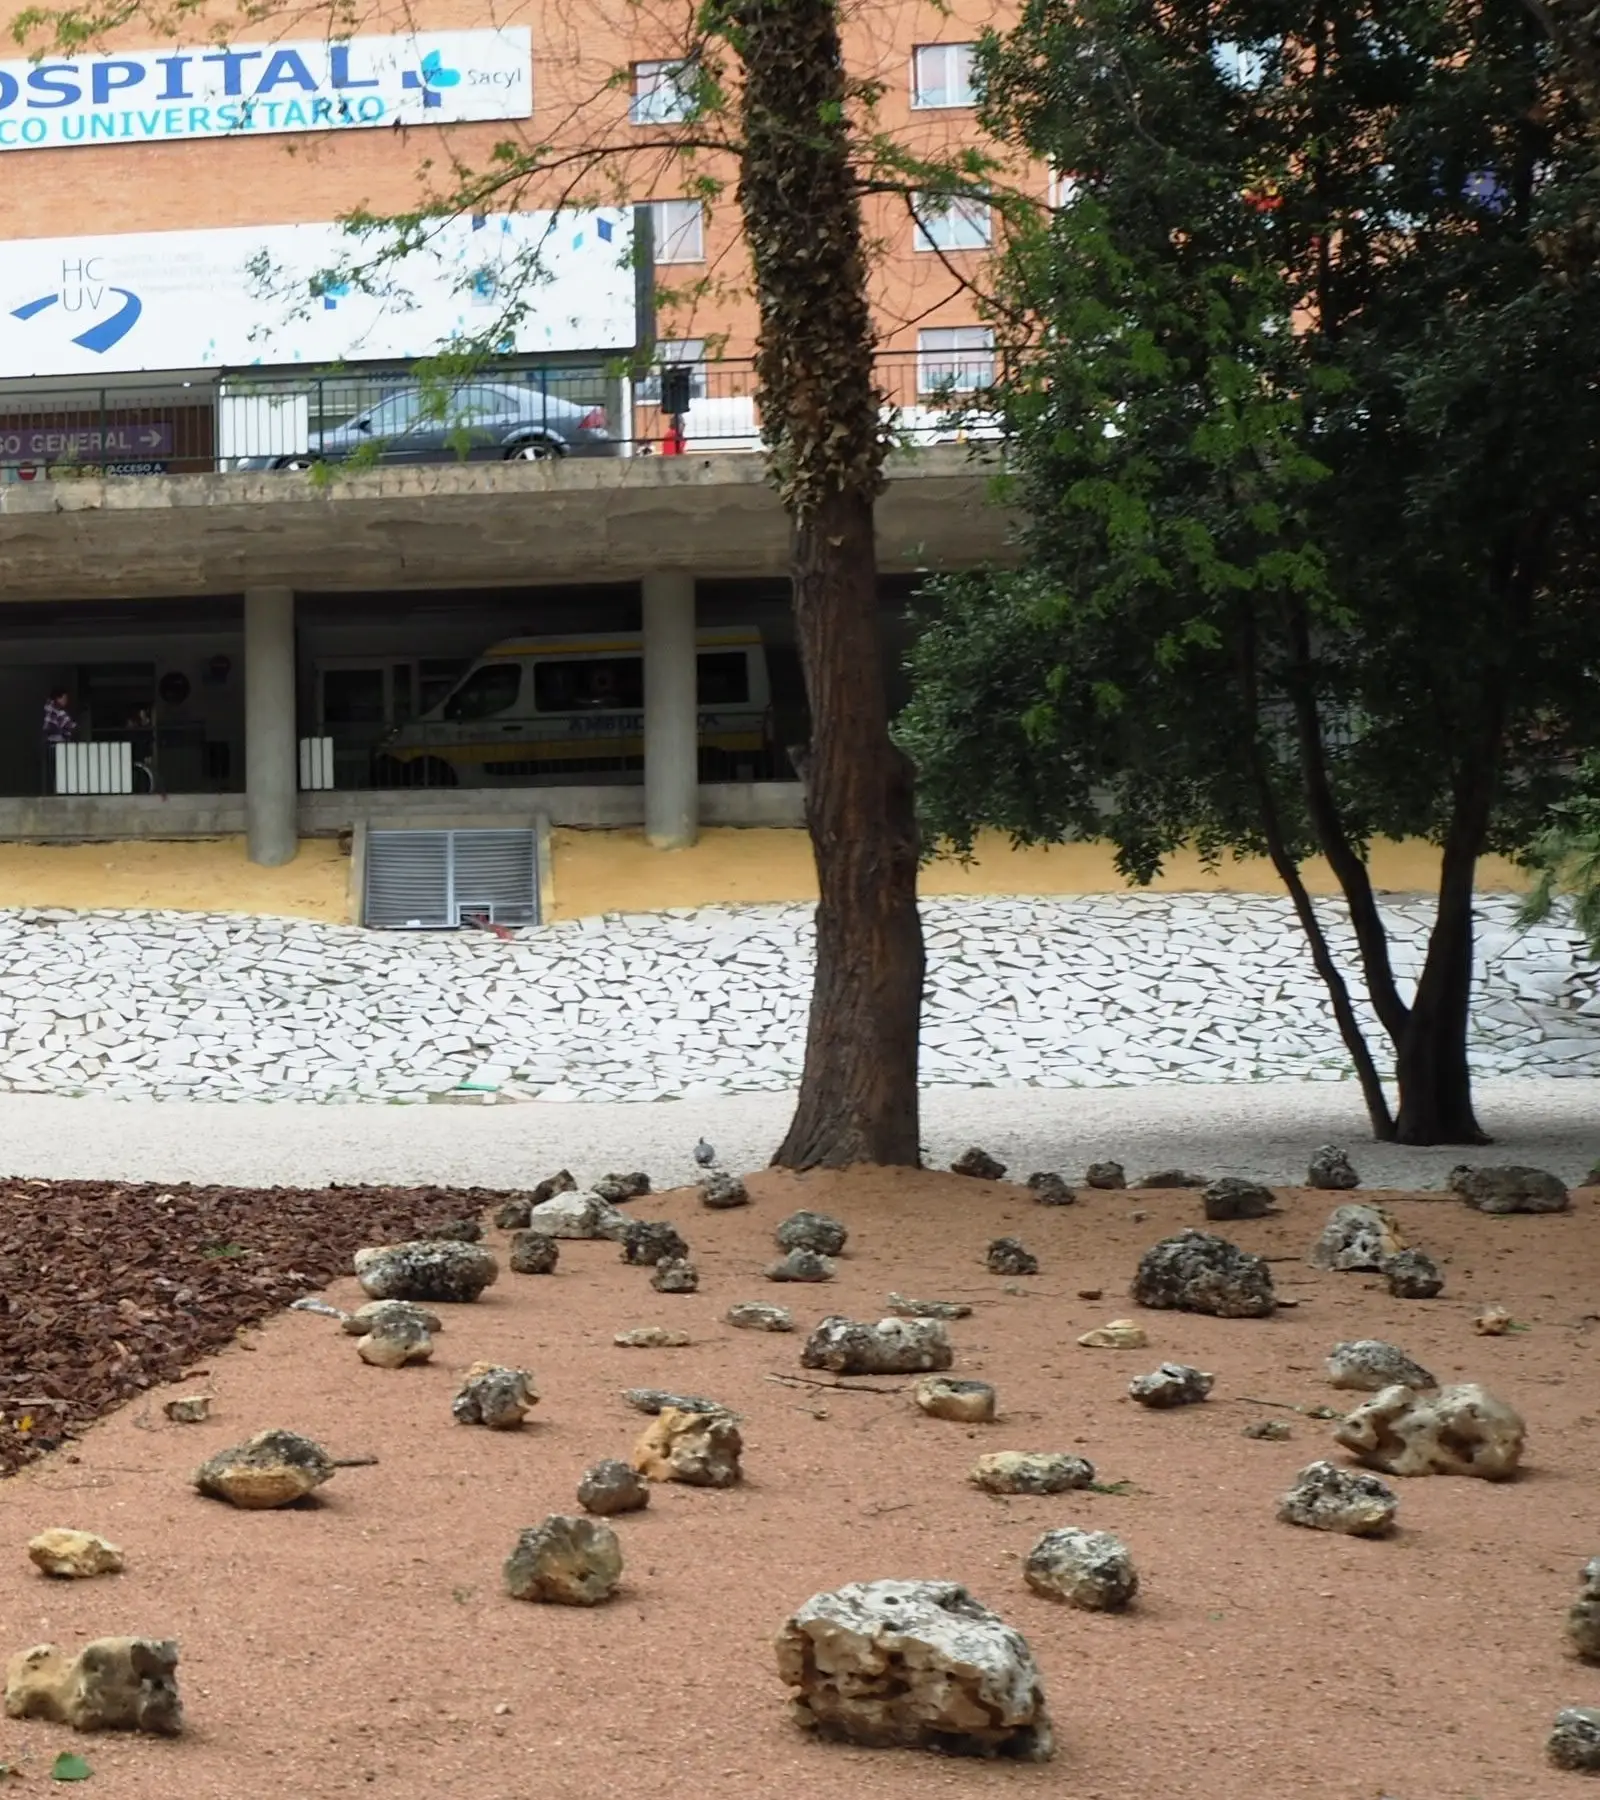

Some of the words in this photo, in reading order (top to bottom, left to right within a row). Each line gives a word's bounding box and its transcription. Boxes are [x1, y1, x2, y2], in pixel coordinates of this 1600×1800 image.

[467, 67, 521, 88] Sacyl
[61, 96, 385, 141] UNIVERSITARIO
[62, 257, 104, 282] HC
[62, 286, 104, 312] UV
[31, 431, 131, 453] GENERAL
